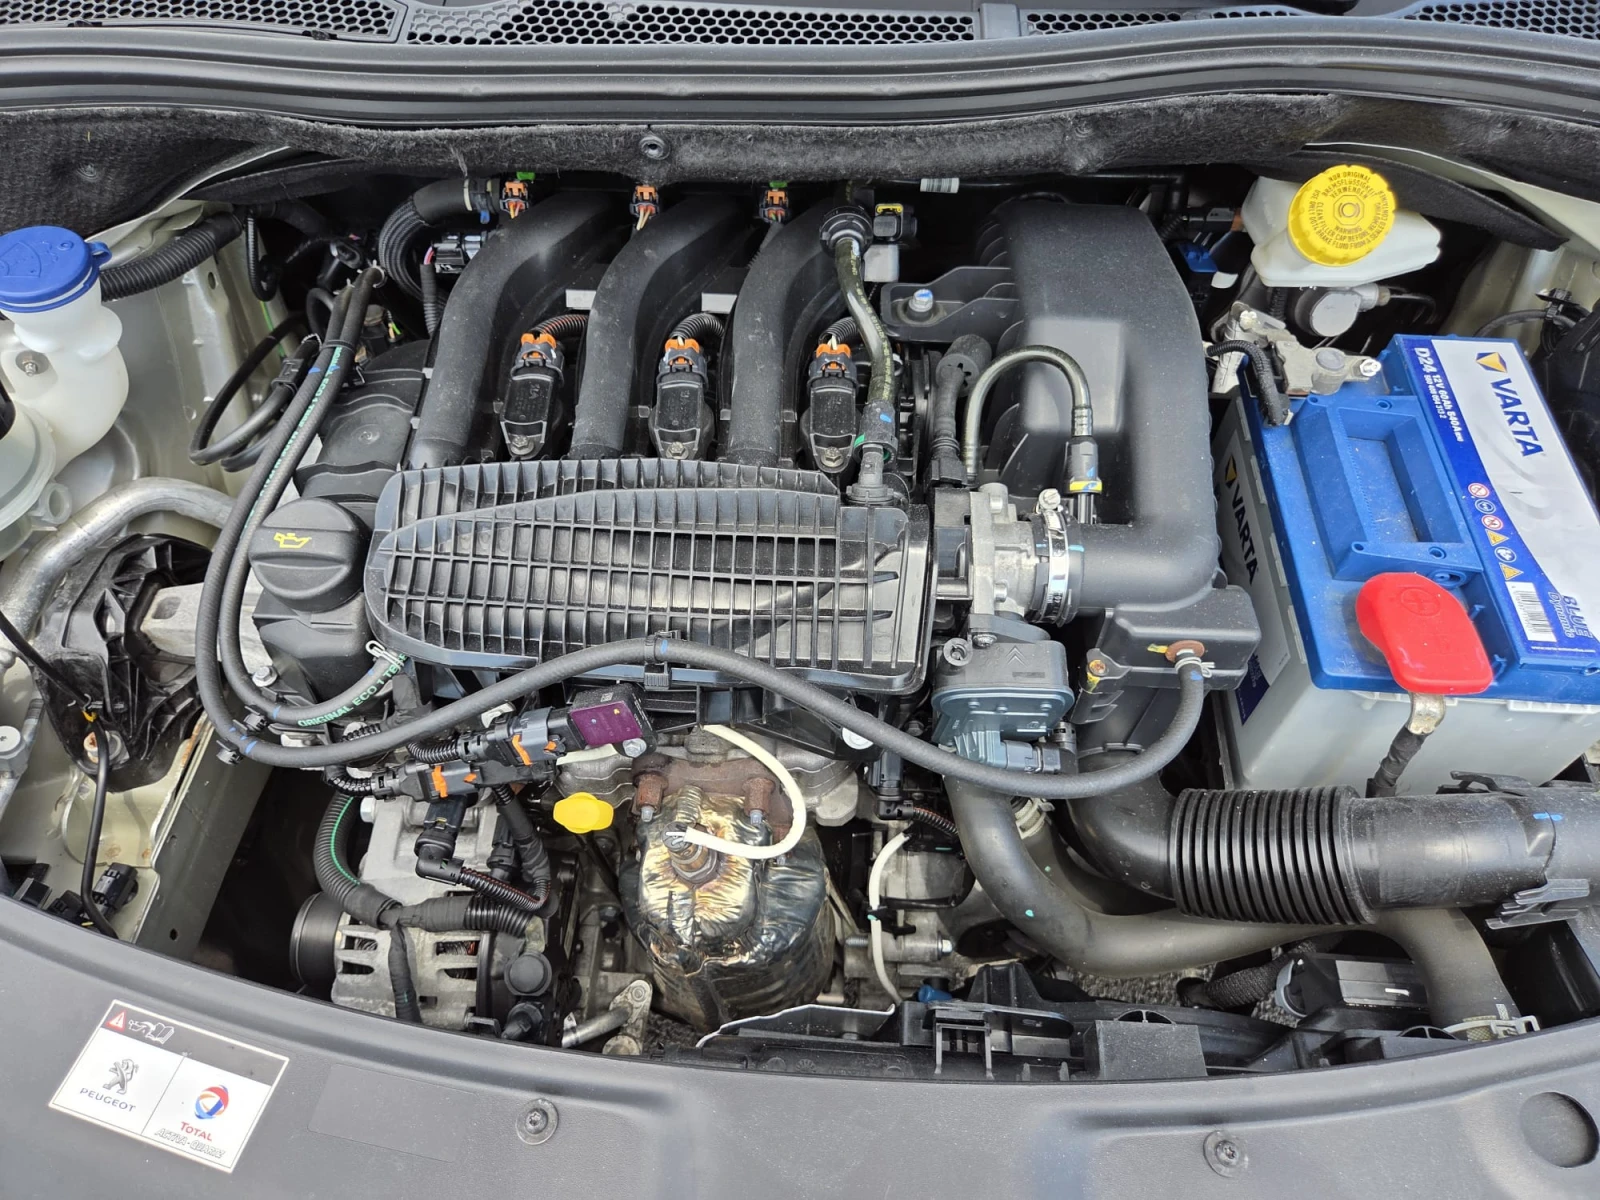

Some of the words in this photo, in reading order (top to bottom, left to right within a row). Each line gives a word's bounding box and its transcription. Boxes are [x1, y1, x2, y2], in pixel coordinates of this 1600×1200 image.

[1343, 172, 1371, 183] ORIGINAL
[1321, 221, 1335, 236] FILLER
[1414, 348, 1437, 372] D24
[1432, 374, 1445, 389] 12V
[1490, 377, 1544, 457] VARTA
[1230, 483, 1258, 585] VARTA
[1562, 595, 1592, 638] BLUE
[297, 705, 354, 727] ORIGINAL
[352, 685, 378, 706] ECO
[79, 1087, 136, 1112] PEUGEOT
